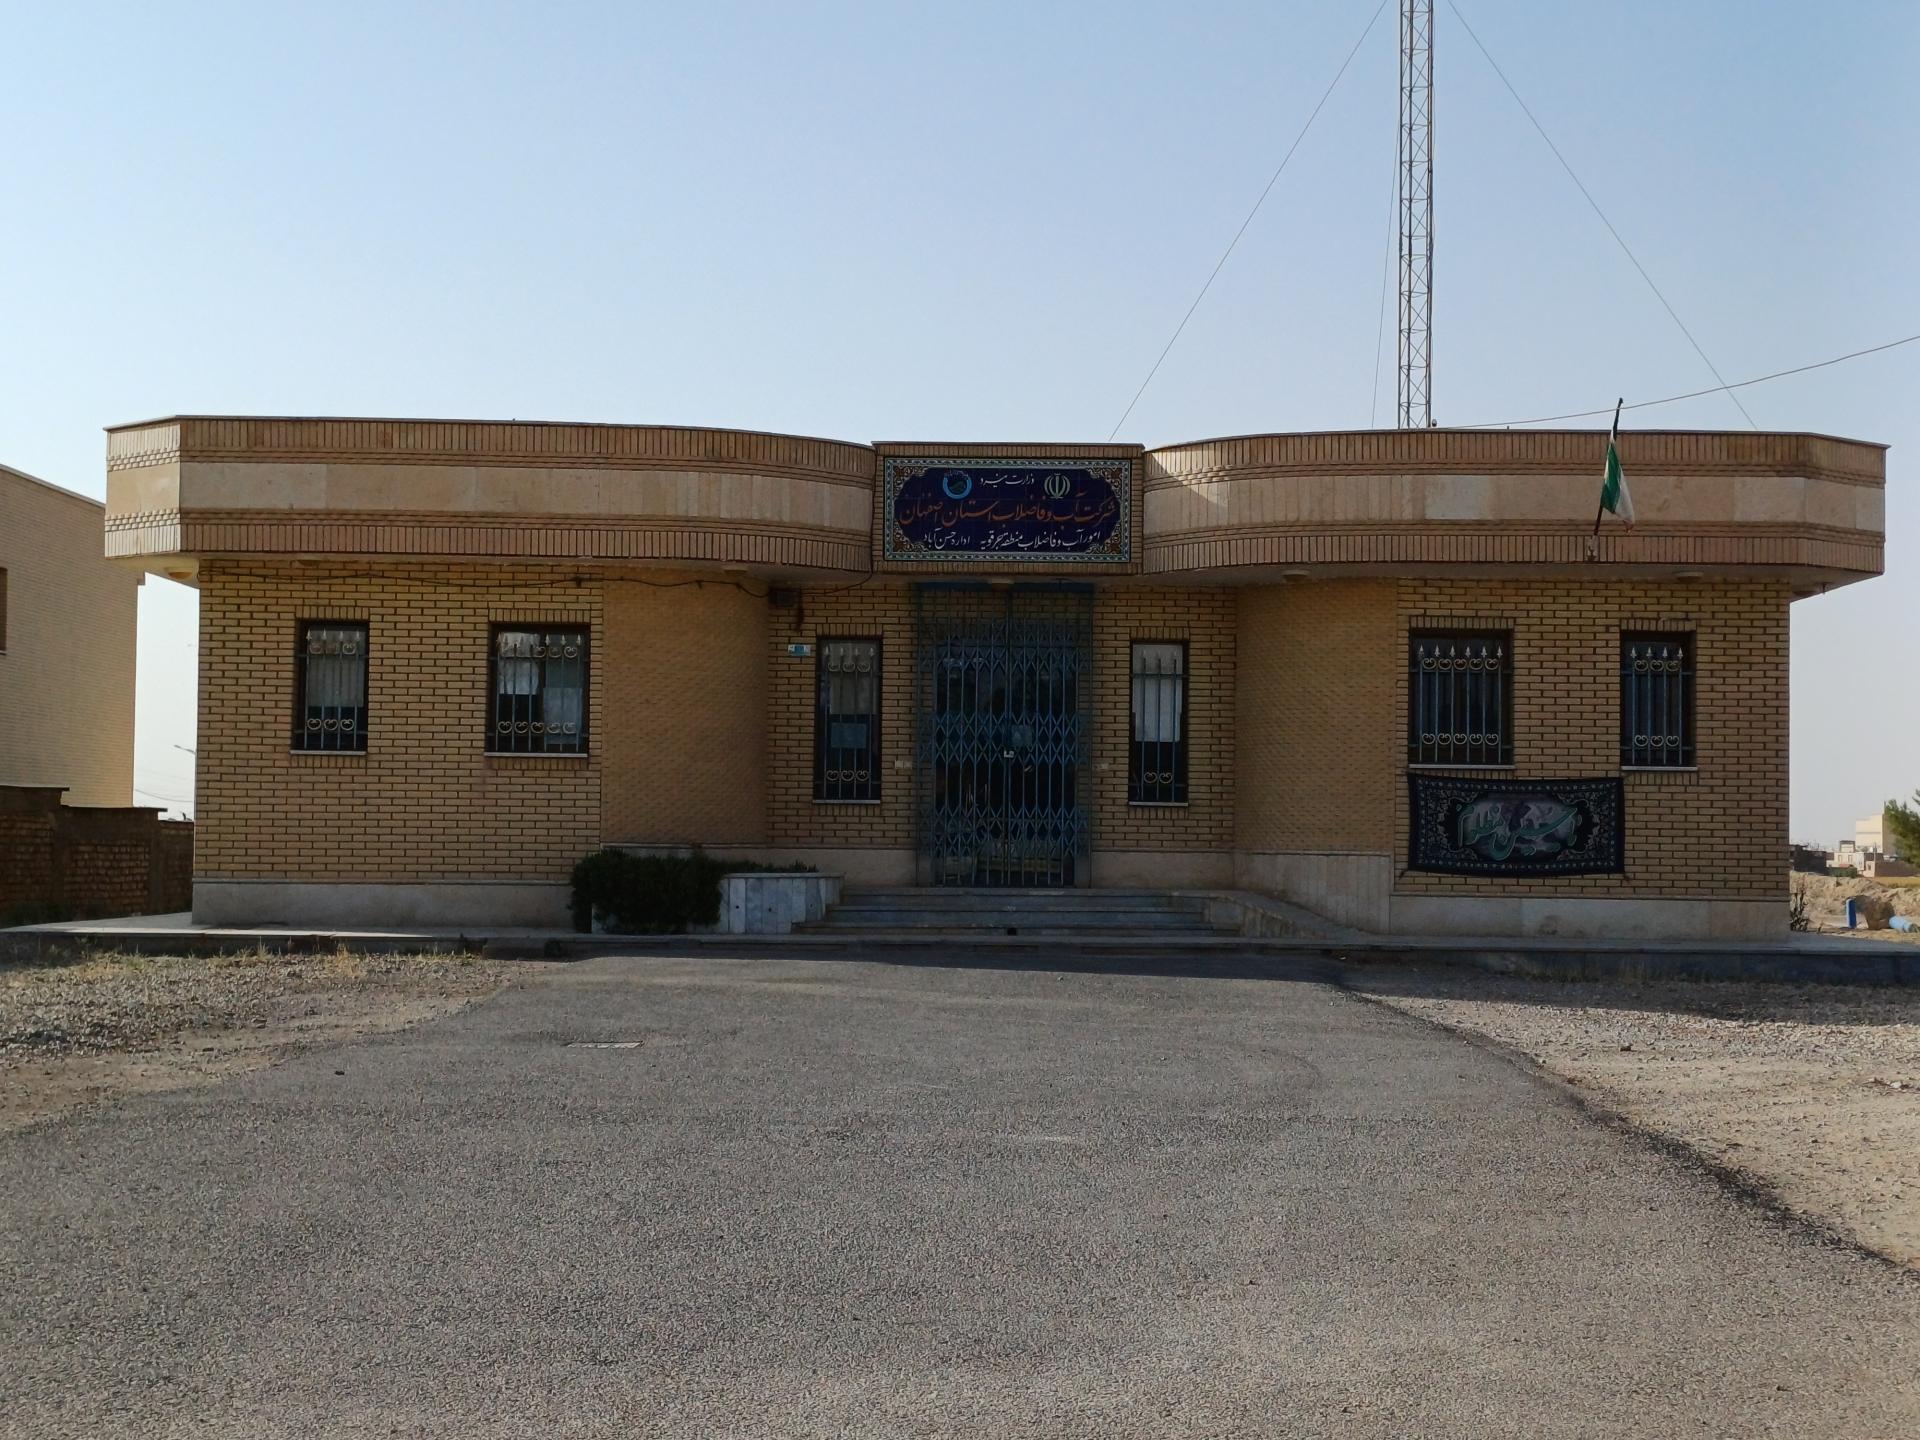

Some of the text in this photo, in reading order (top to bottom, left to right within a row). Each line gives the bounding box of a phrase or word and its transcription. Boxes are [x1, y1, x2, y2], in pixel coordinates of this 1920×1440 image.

[980, 472, 1035, 488] وزارت نیرو
[900, 492, 944, 525] اصفهان
[942, 499, 1000, 528] استان
[1052, 489, 1087, 530] آب
[1073, 495, 1118, 528] شرکت
[951, 534, 971, 546] اداره
[1000, 530, 1024, 547] منطقه
[1062, 528, 1085, 550] آب
[1083, 529, 1101, 545] امور
